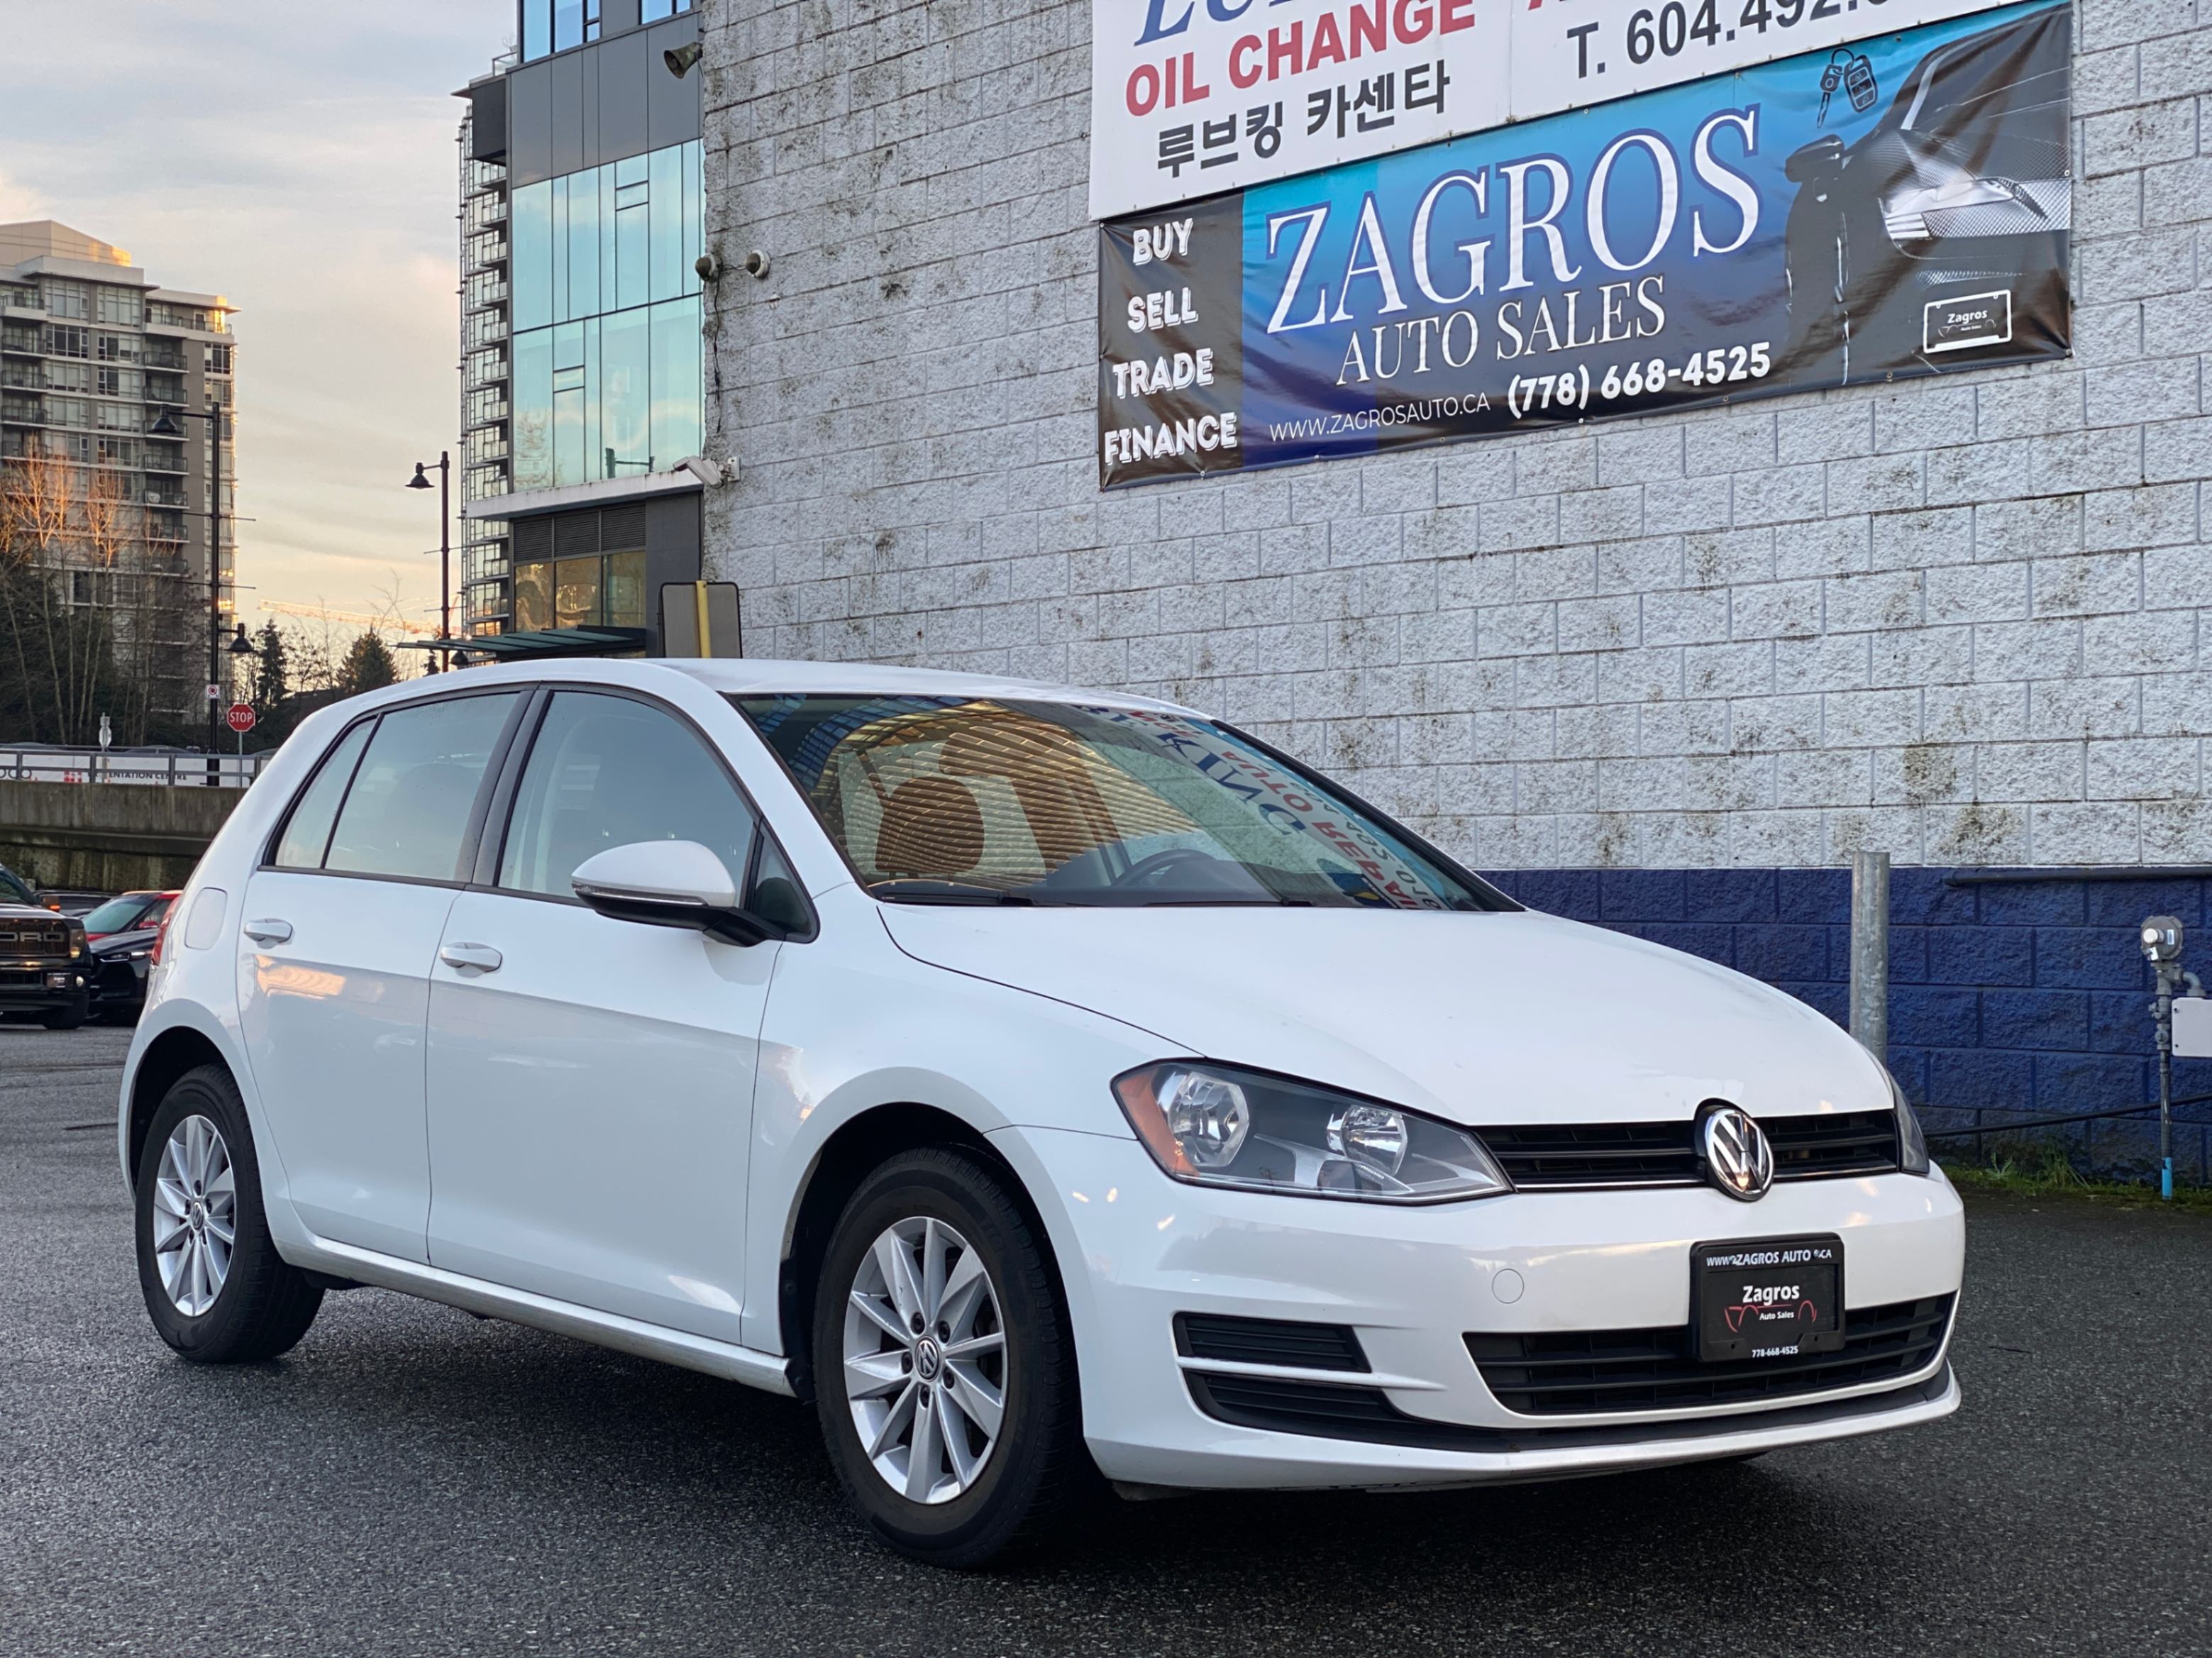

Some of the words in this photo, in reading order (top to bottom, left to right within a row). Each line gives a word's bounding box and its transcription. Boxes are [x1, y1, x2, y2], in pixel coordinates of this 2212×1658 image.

[1126, 52, 1210, 116] OIL
[1228, 0, 1476, 89] CHANGE
[1566, 22, 1606, 79] T.
[1157, 101, 1283, 179] 루브킹
[1307, 60, 1451, 139] 카센타
[1132, 217, 1194, 266] BUY
[1266, 108, 1762, 335] ZAGROS
[1127, 287, 1199, 333] SELL
[1335, 310, 1479, 386] AUTO
[1496, 275, 1666, 361] SALES
[1947, 309, 1988, 324] Zagros
[1112, 348, 1214, 399] TRADE
[1269, 392, 1491, 443] WWW.ZAGROSAUTO.CA
[1508, 364, 1590, 419] (778)
[1600, 341, 1771, 400] 668-4525
[1104, 411, 1237, 466] FINANCE
[229, 712, 253, 722] STOP
[1736, 1251, 1779, 1266] ZAGROS
[1781, 1249, 1811, 1263] AUTO
[1742, 1285, 1801, 1306] Zagros
[1777, 1310, 1794, 1319] Sales
[1752, 1345, 1799, 1358] 778-668-4525
